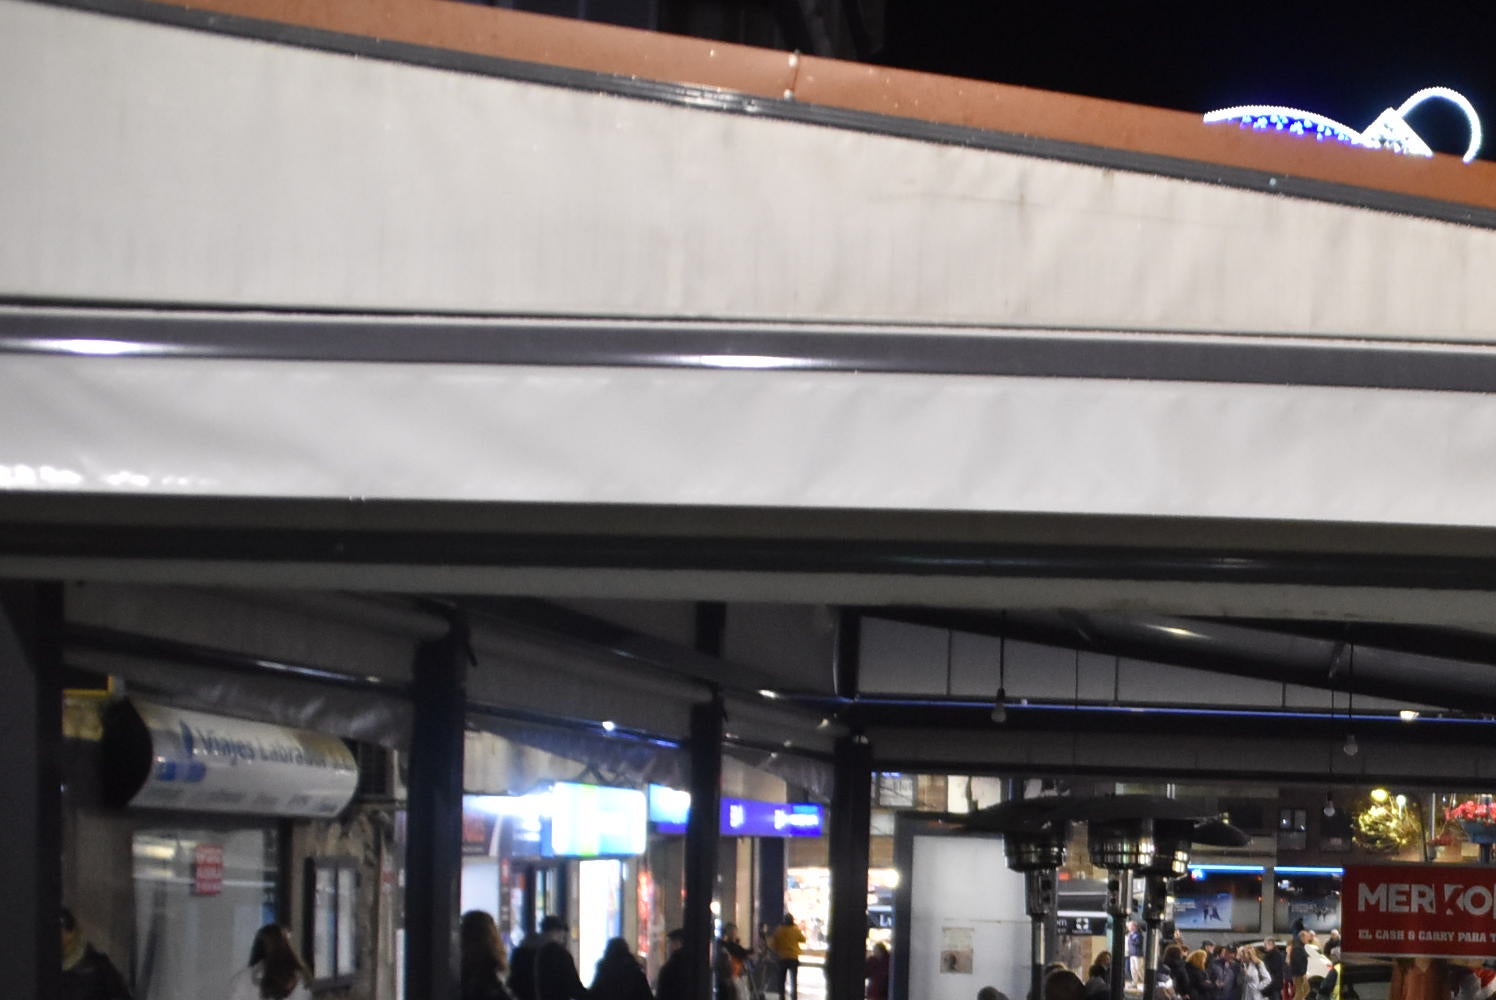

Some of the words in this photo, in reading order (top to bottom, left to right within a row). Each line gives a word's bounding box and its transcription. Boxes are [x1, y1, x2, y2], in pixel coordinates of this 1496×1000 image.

[1358, 928, 1373, 940] EL
[1375, 929, 1405, 941] CASH
[1418, 930, 1455, 942] CARRY
[1457, 931, 1487, 943] PARA
